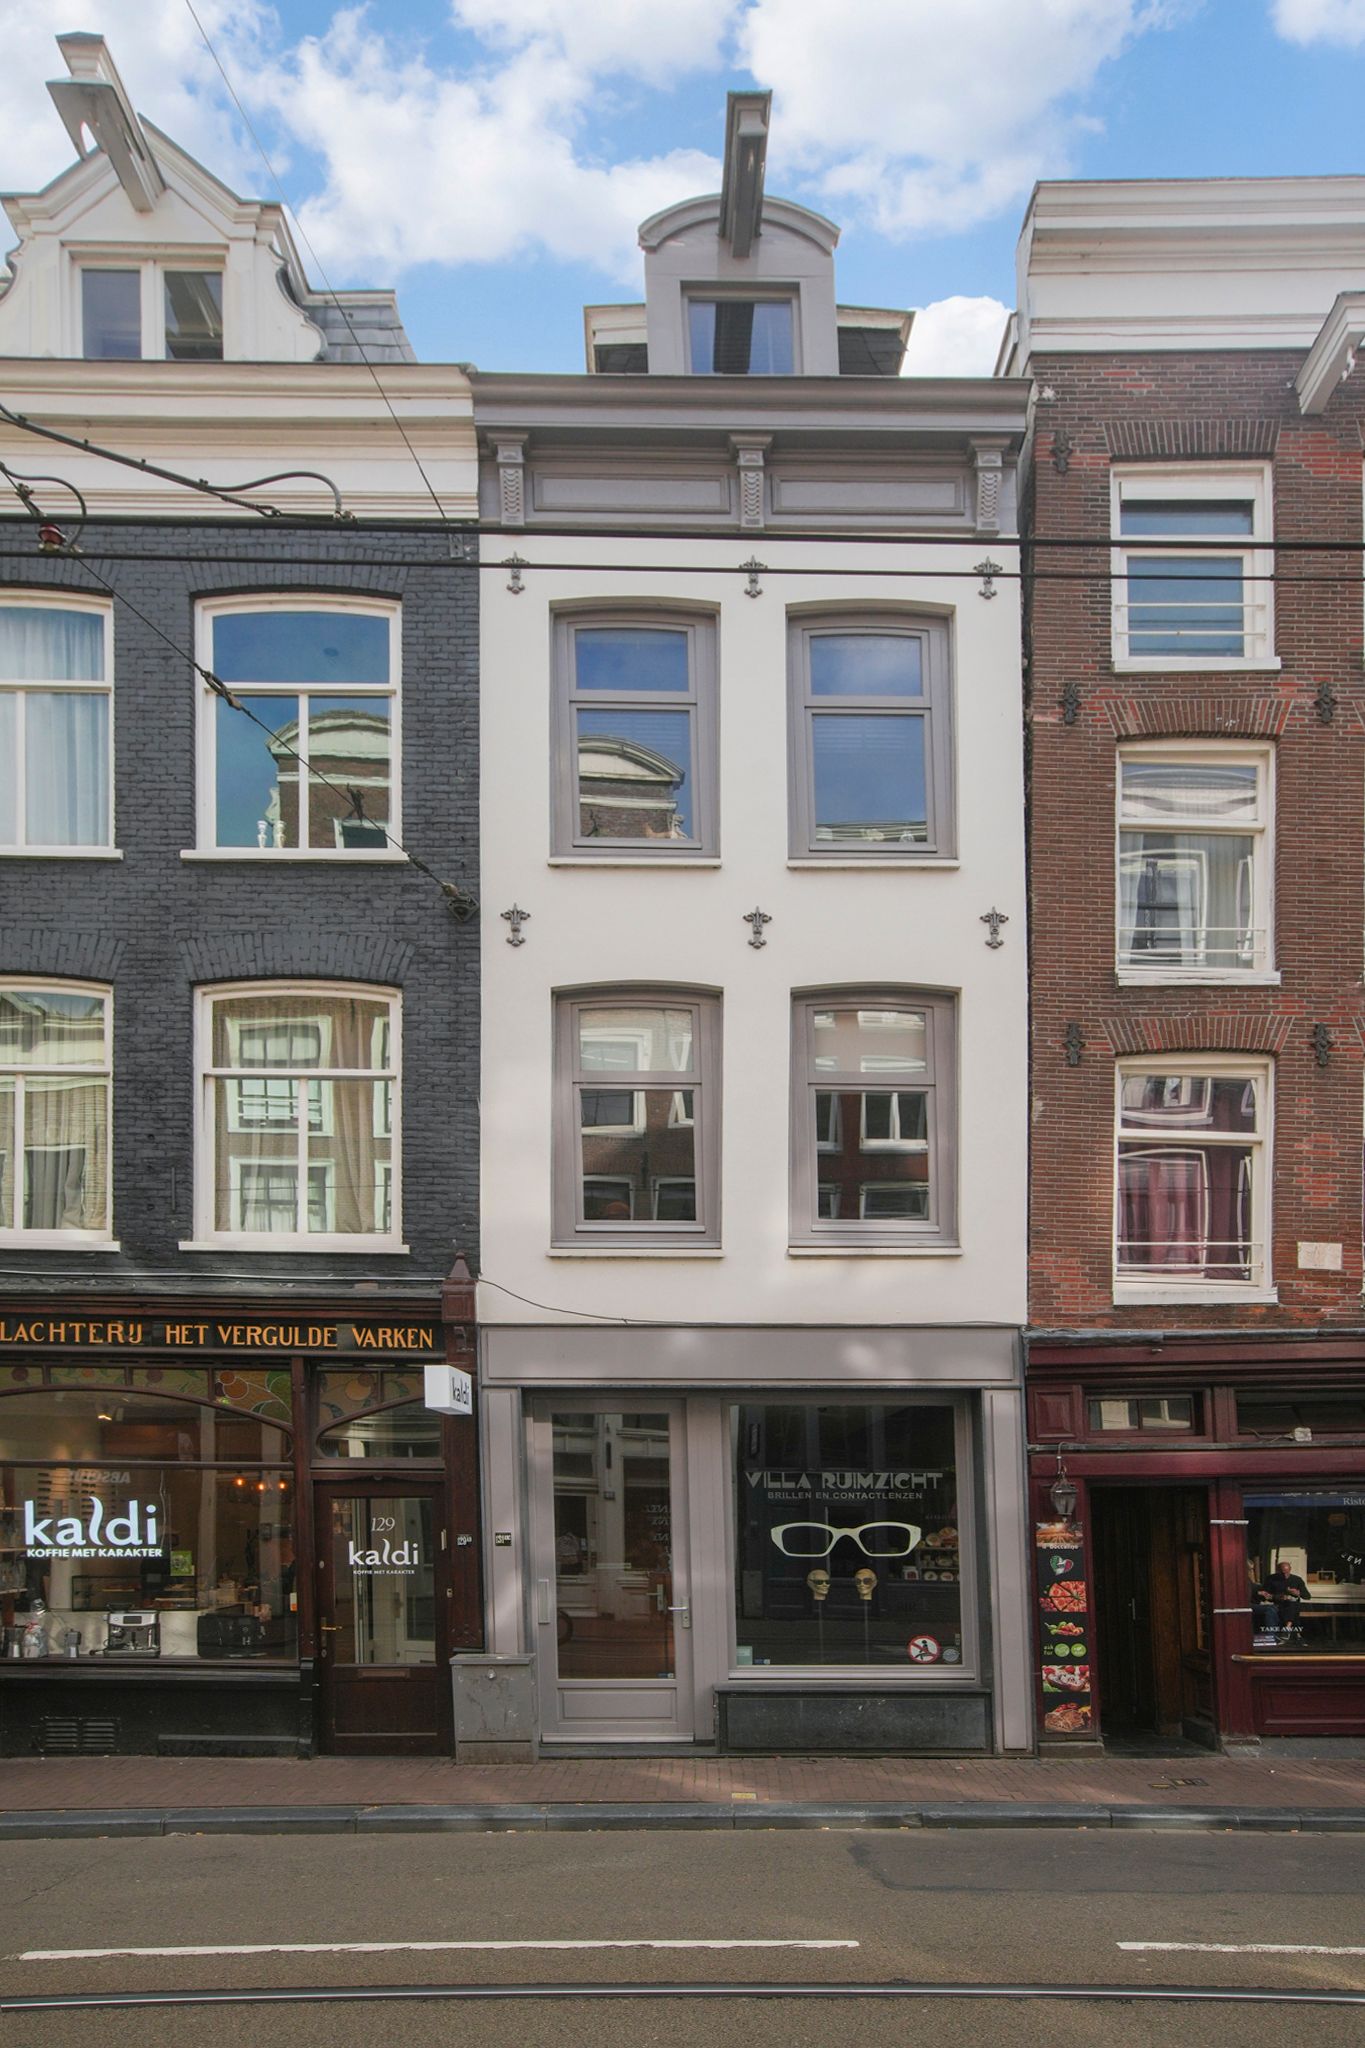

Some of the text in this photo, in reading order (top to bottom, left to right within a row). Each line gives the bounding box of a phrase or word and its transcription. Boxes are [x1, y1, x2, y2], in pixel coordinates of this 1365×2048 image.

[165, 1324, 209, 1345] HET
[217, 1324, 337, 1347] VERGULDE
[351, 1327, 433, 1349] VARKEN
[452, 1376, 470, 1405] kaldi
[745, 1471, 944, 1490] VILLA RUIMZICHT
[767, 1491, 923, 1500] BRILLEN EN CONTACTLENZEN
[24, 1496, 157, 1546] kaldi
[371, 1517, 396, 1532] 129
[27, 1548, 163, 1558] KOFFIE MET KARAKTER
[348, 1538, 419, 1566] kaldi
